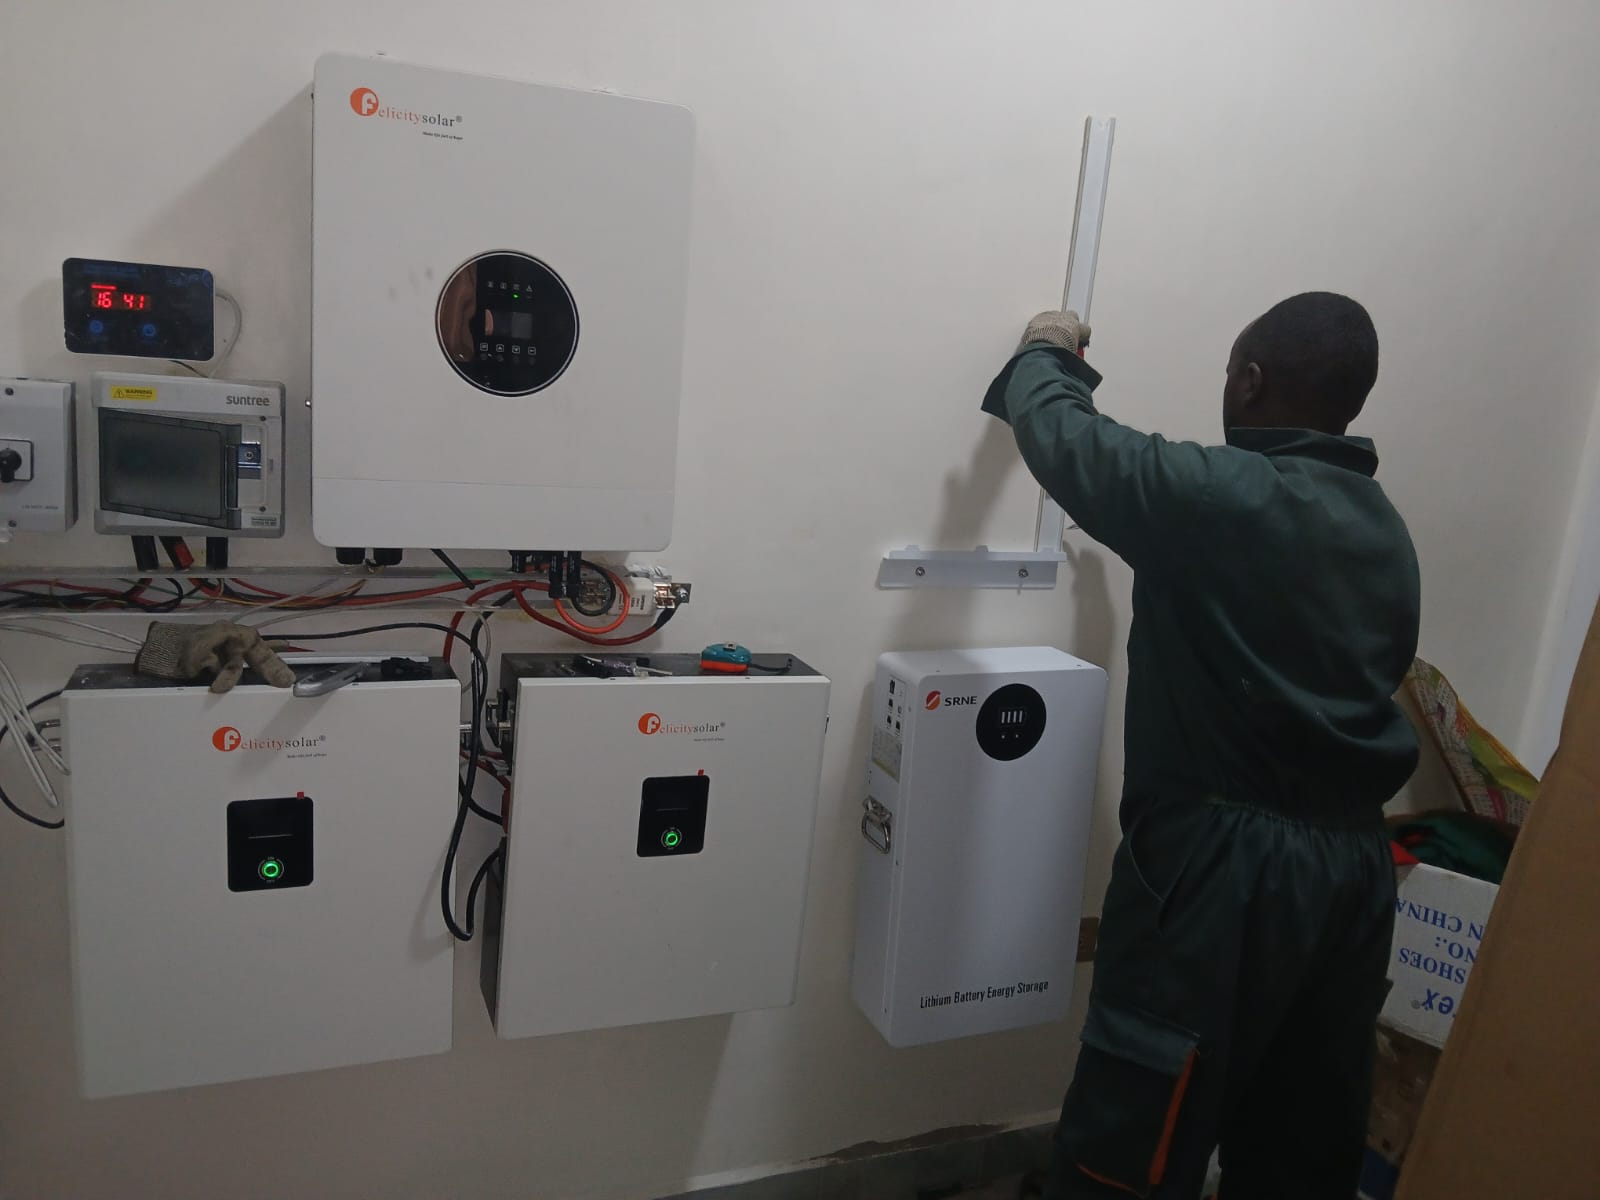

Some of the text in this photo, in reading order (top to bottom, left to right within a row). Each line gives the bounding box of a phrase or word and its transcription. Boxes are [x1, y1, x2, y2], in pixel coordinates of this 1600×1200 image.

[97, 291, 145, 309] 16 41
[225, 395, 270, 407] suntree
[944, 695, 977, 707] SRNE
[1395, 897, 1463, 934] CHINA
[1399, 947, 1467, 984] SHOES
[920, 981, 1049, 1009] Lithium Battery Energy Storage
